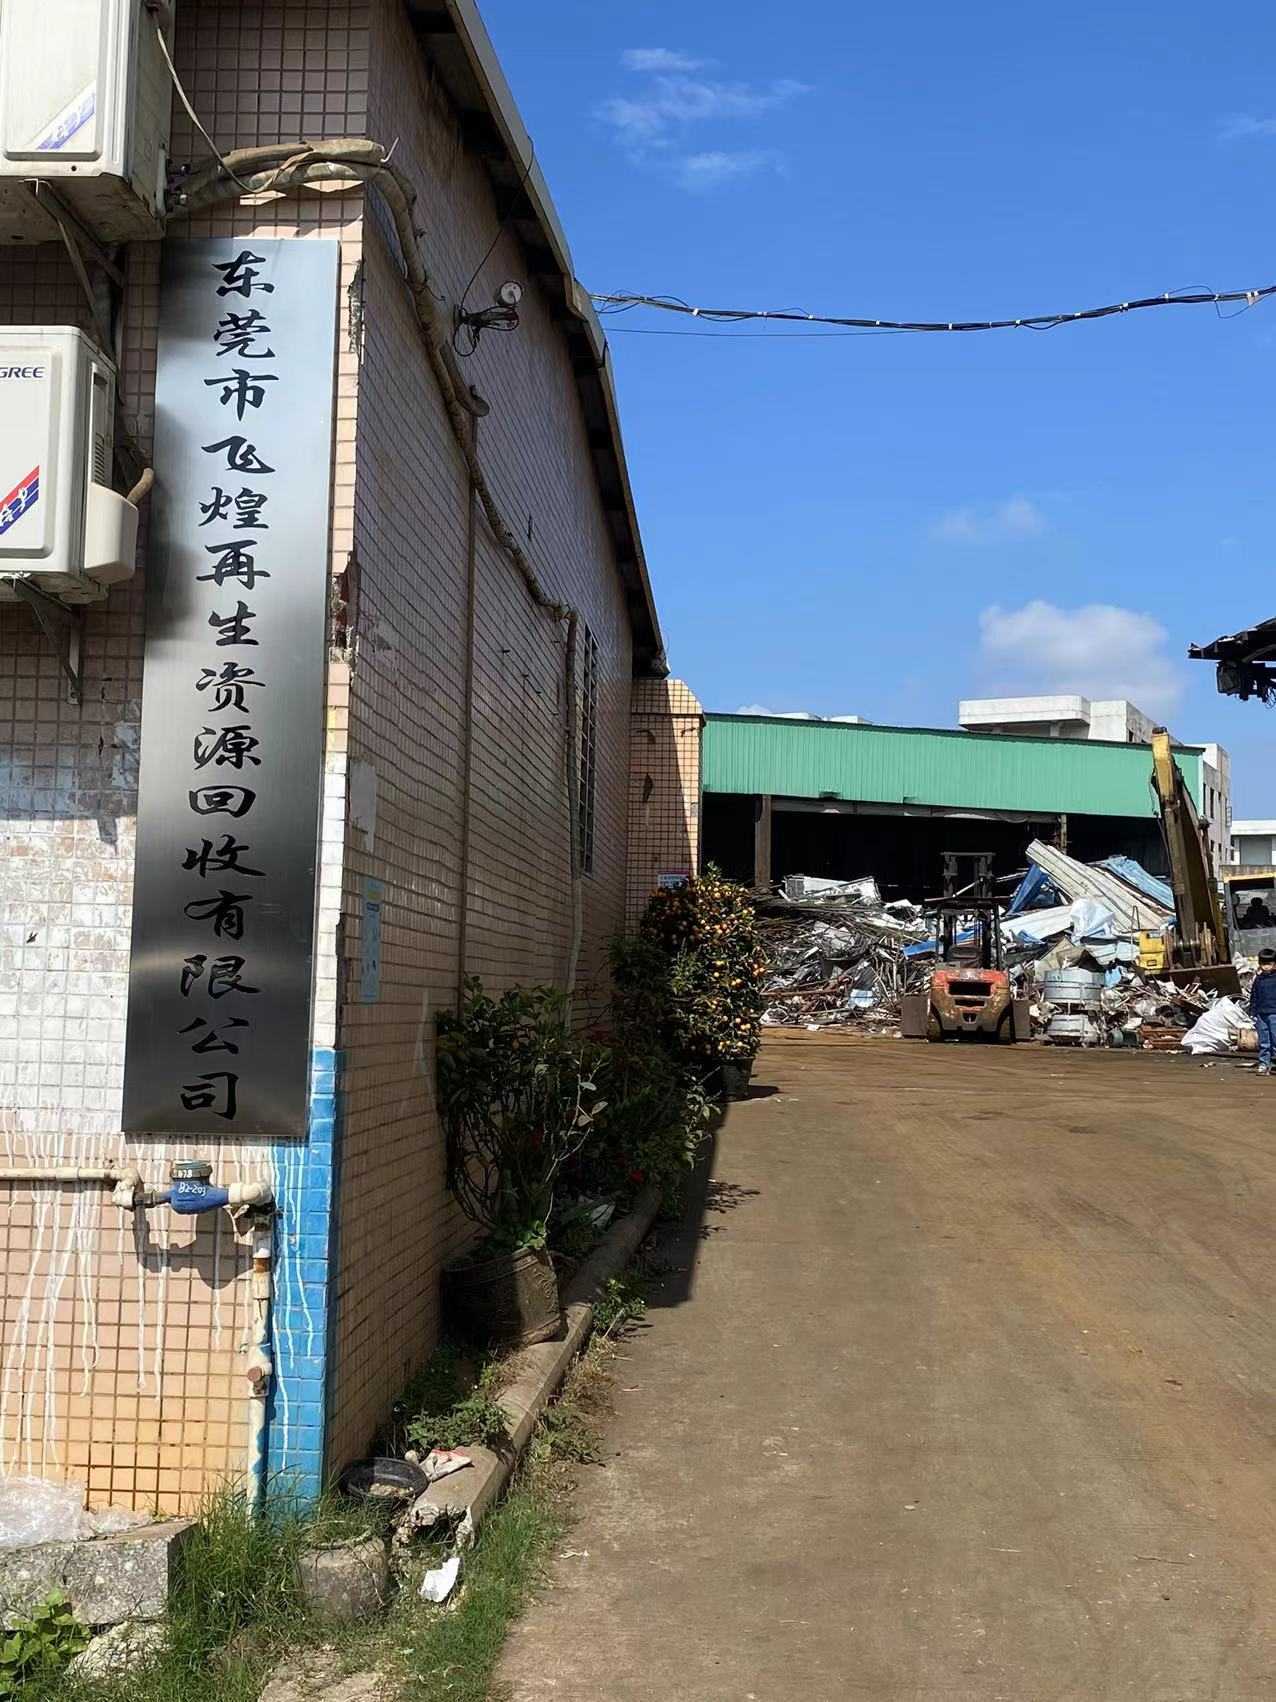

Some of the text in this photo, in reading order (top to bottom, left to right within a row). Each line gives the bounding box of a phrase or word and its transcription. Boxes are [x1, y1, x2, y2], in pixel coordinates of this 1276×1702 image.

[177, 250, 279, 1121] 东莞市飞煌再生资源回收有限公司
